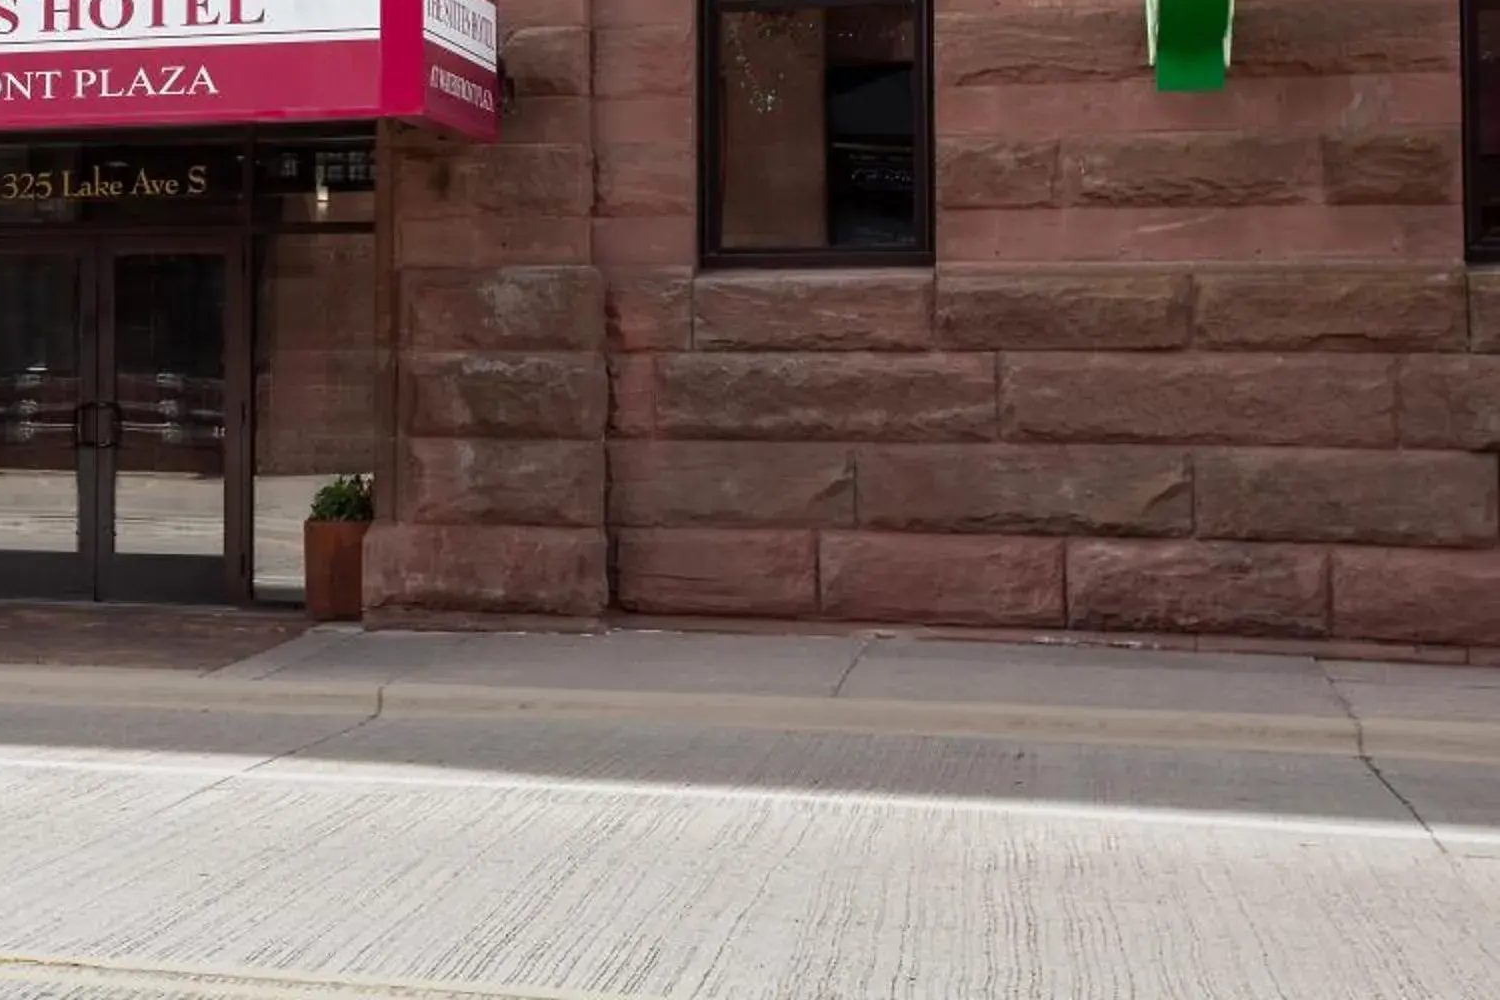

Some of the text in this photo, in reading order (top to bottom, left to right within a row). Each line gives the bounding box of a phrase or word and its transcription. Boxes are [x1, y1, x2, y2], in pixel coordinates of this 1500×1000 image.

[71, 64, 220, 100] PLAZA
[2, 164, 208, 200] 325 Lake Ave S
